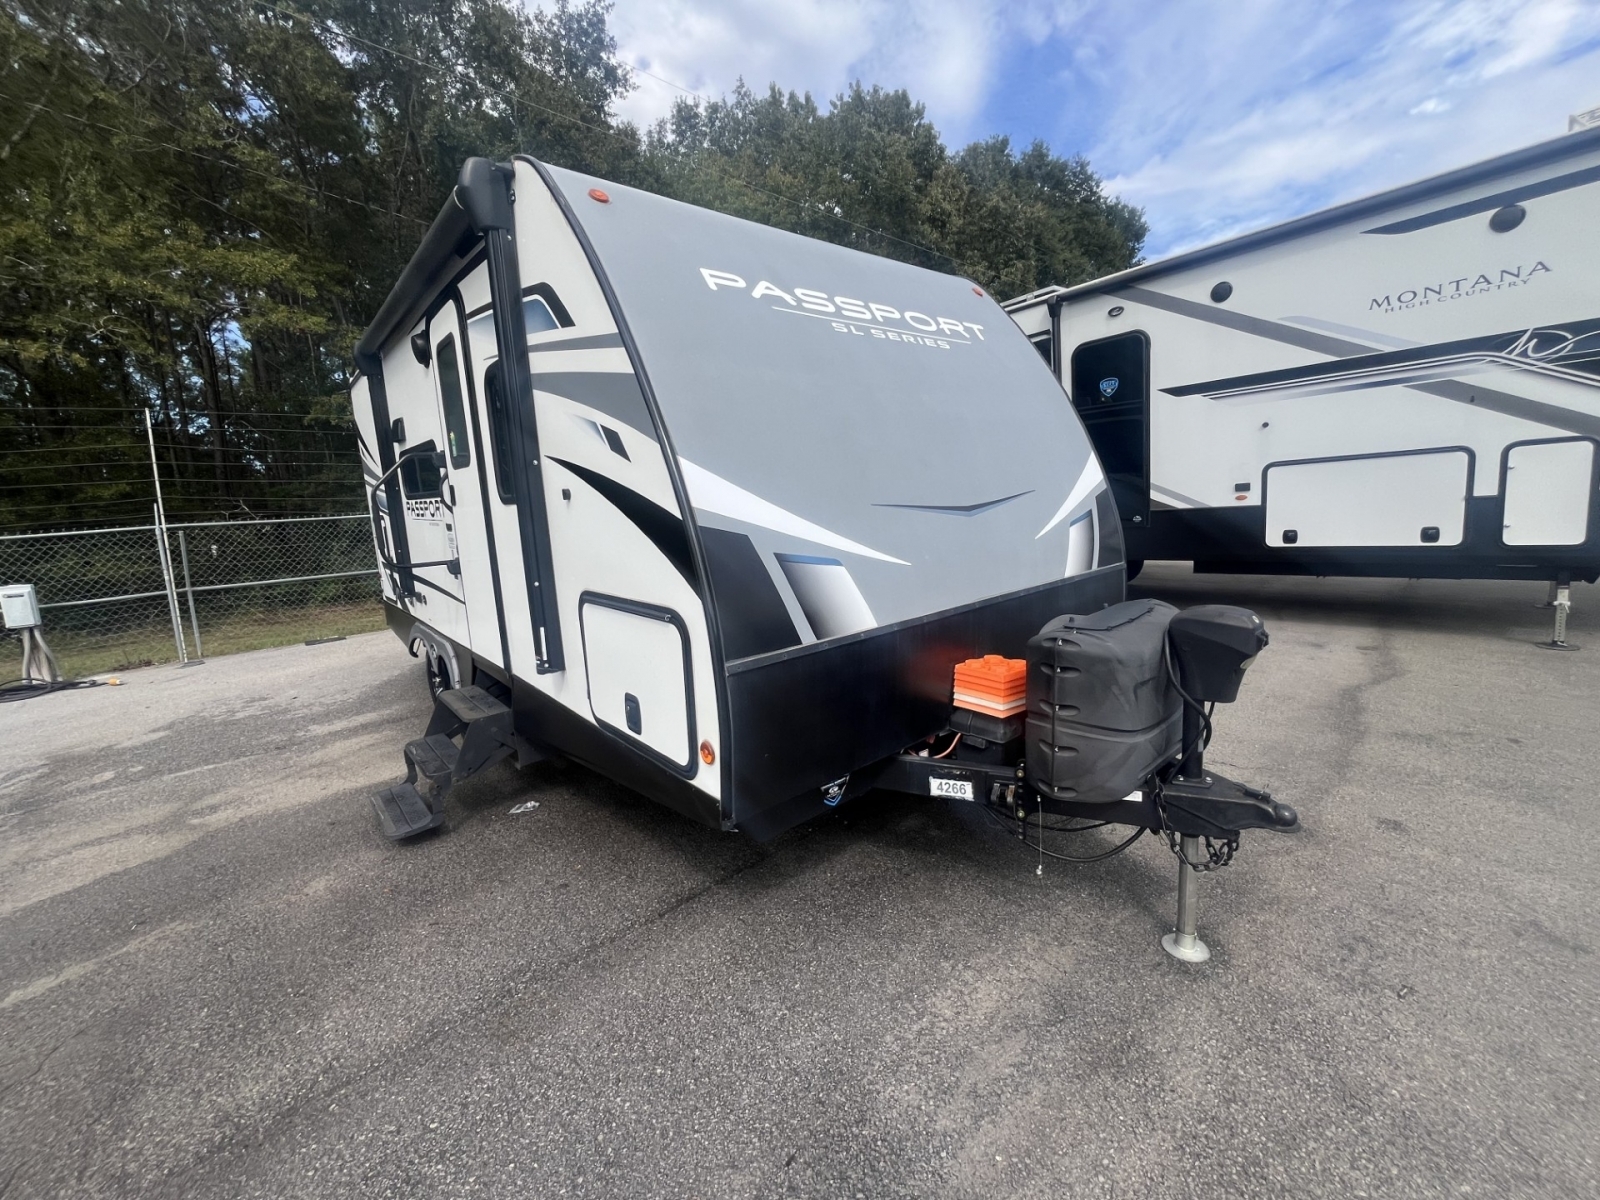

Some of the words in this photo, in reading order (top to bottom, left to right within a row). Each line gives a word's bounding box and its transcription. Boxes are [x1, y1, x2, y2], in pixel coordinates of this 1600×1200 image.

[699, 267, 985, 341] PASSPORT
[1368, 261, 1553, 311] MONTANA
[1384, 299, 1430, 314] HIGH
[1437, 277, 1531, 303] COUNTRY
[831, 322, 865, 336] SL
[869, 329, 951, 350] SERIES
[936, 781, 967, 795] 4266
